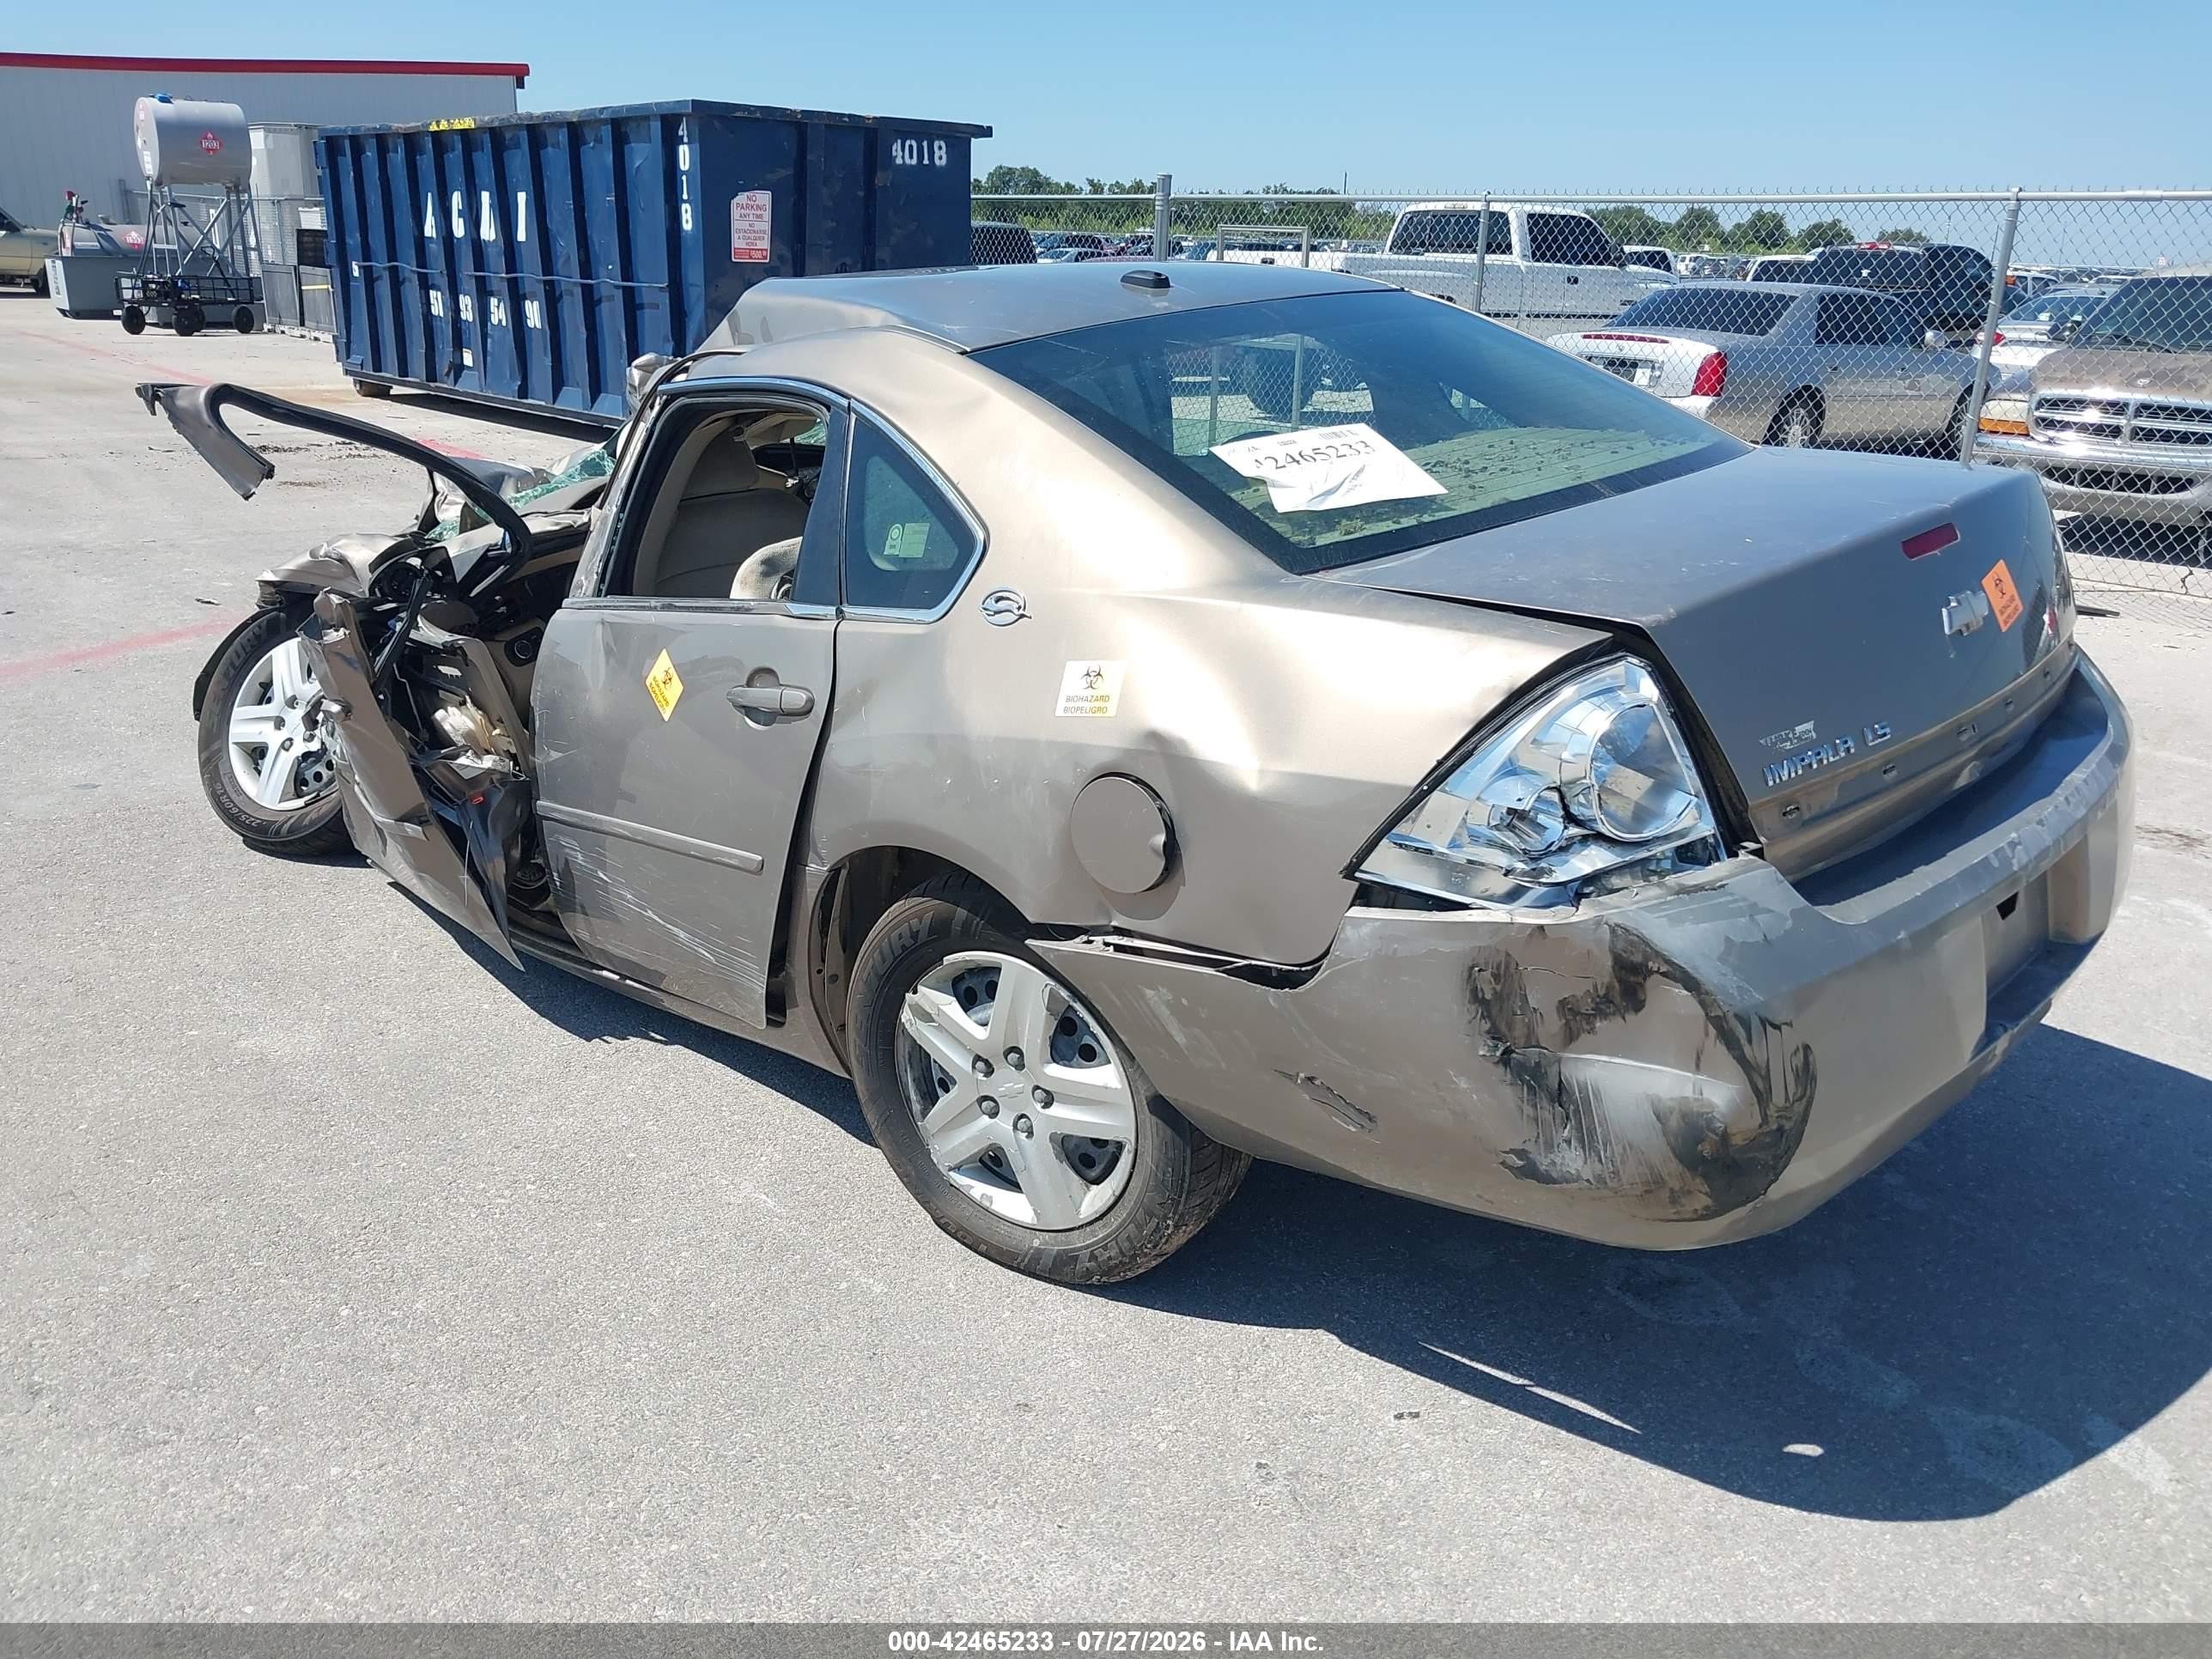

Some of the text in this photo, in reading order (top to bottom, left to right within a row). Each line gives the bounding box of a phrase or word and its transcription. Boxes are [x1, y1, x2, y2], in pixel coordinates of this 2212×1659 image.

[891, 138, 947, 166] 4018
[678, 117, 693, 231] 4018
[735, 202, 768, 212] PARKING
[746, 194, 757, 203] NO
[1065, 695, 1110, 703] BIOHAZARD
[1063, 706, 1108, 714] BIOPELIGRO
[1763, 735, 1856, 787] IMPALA
[1863, 720, 1892, 747] LS
[215, 782, 262, 827] 225/60R16
